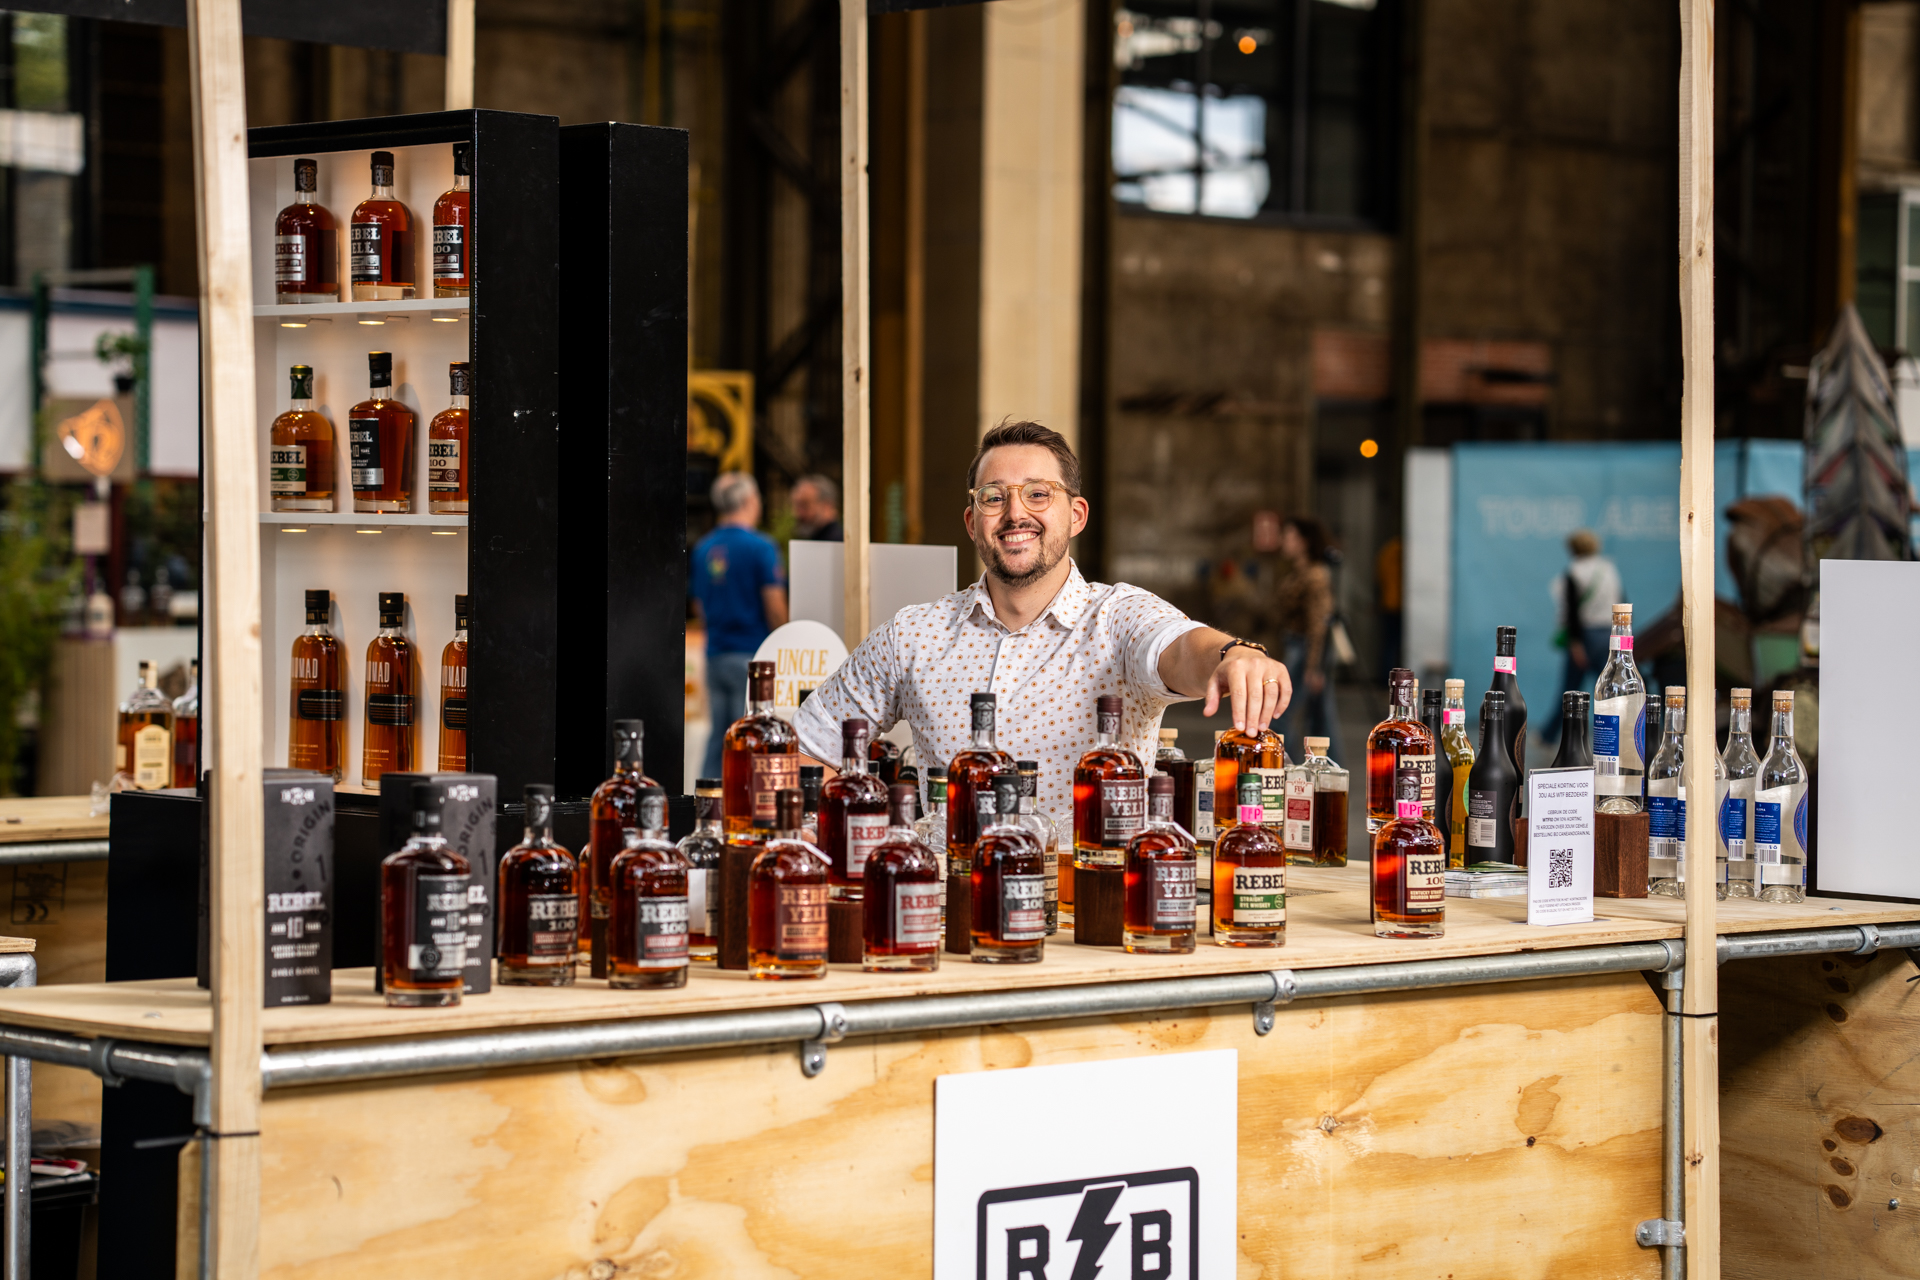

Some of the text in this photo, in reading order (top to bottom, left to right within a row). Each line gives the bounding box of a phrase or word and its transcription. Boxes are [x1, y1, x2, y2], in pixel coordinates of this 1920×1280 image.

[351, 228, 380, 240] EBEL
[352, 242, 374, 254] ELL
[351, 431, 373, 442] EBEL
[271, 451, 304, 464] EBEL
[429, 443, 458, 458] EBEL
[777, 649, 828, 676] UNCLE
[1104, 786, 1144, 800] REBE
[851, 826, 885, 840] REB
[1156, 867, 1196, 881] REBE
[1426, 877, 1445, 885] 100
[1236, 874, 1284, 890] REBEL
[1005, 881, 1044, 899] REBE
[267, 891, 326, 913] REBEL
[530, 900, 578, 920] REBE
[641, 902, 688, 923] REBE
